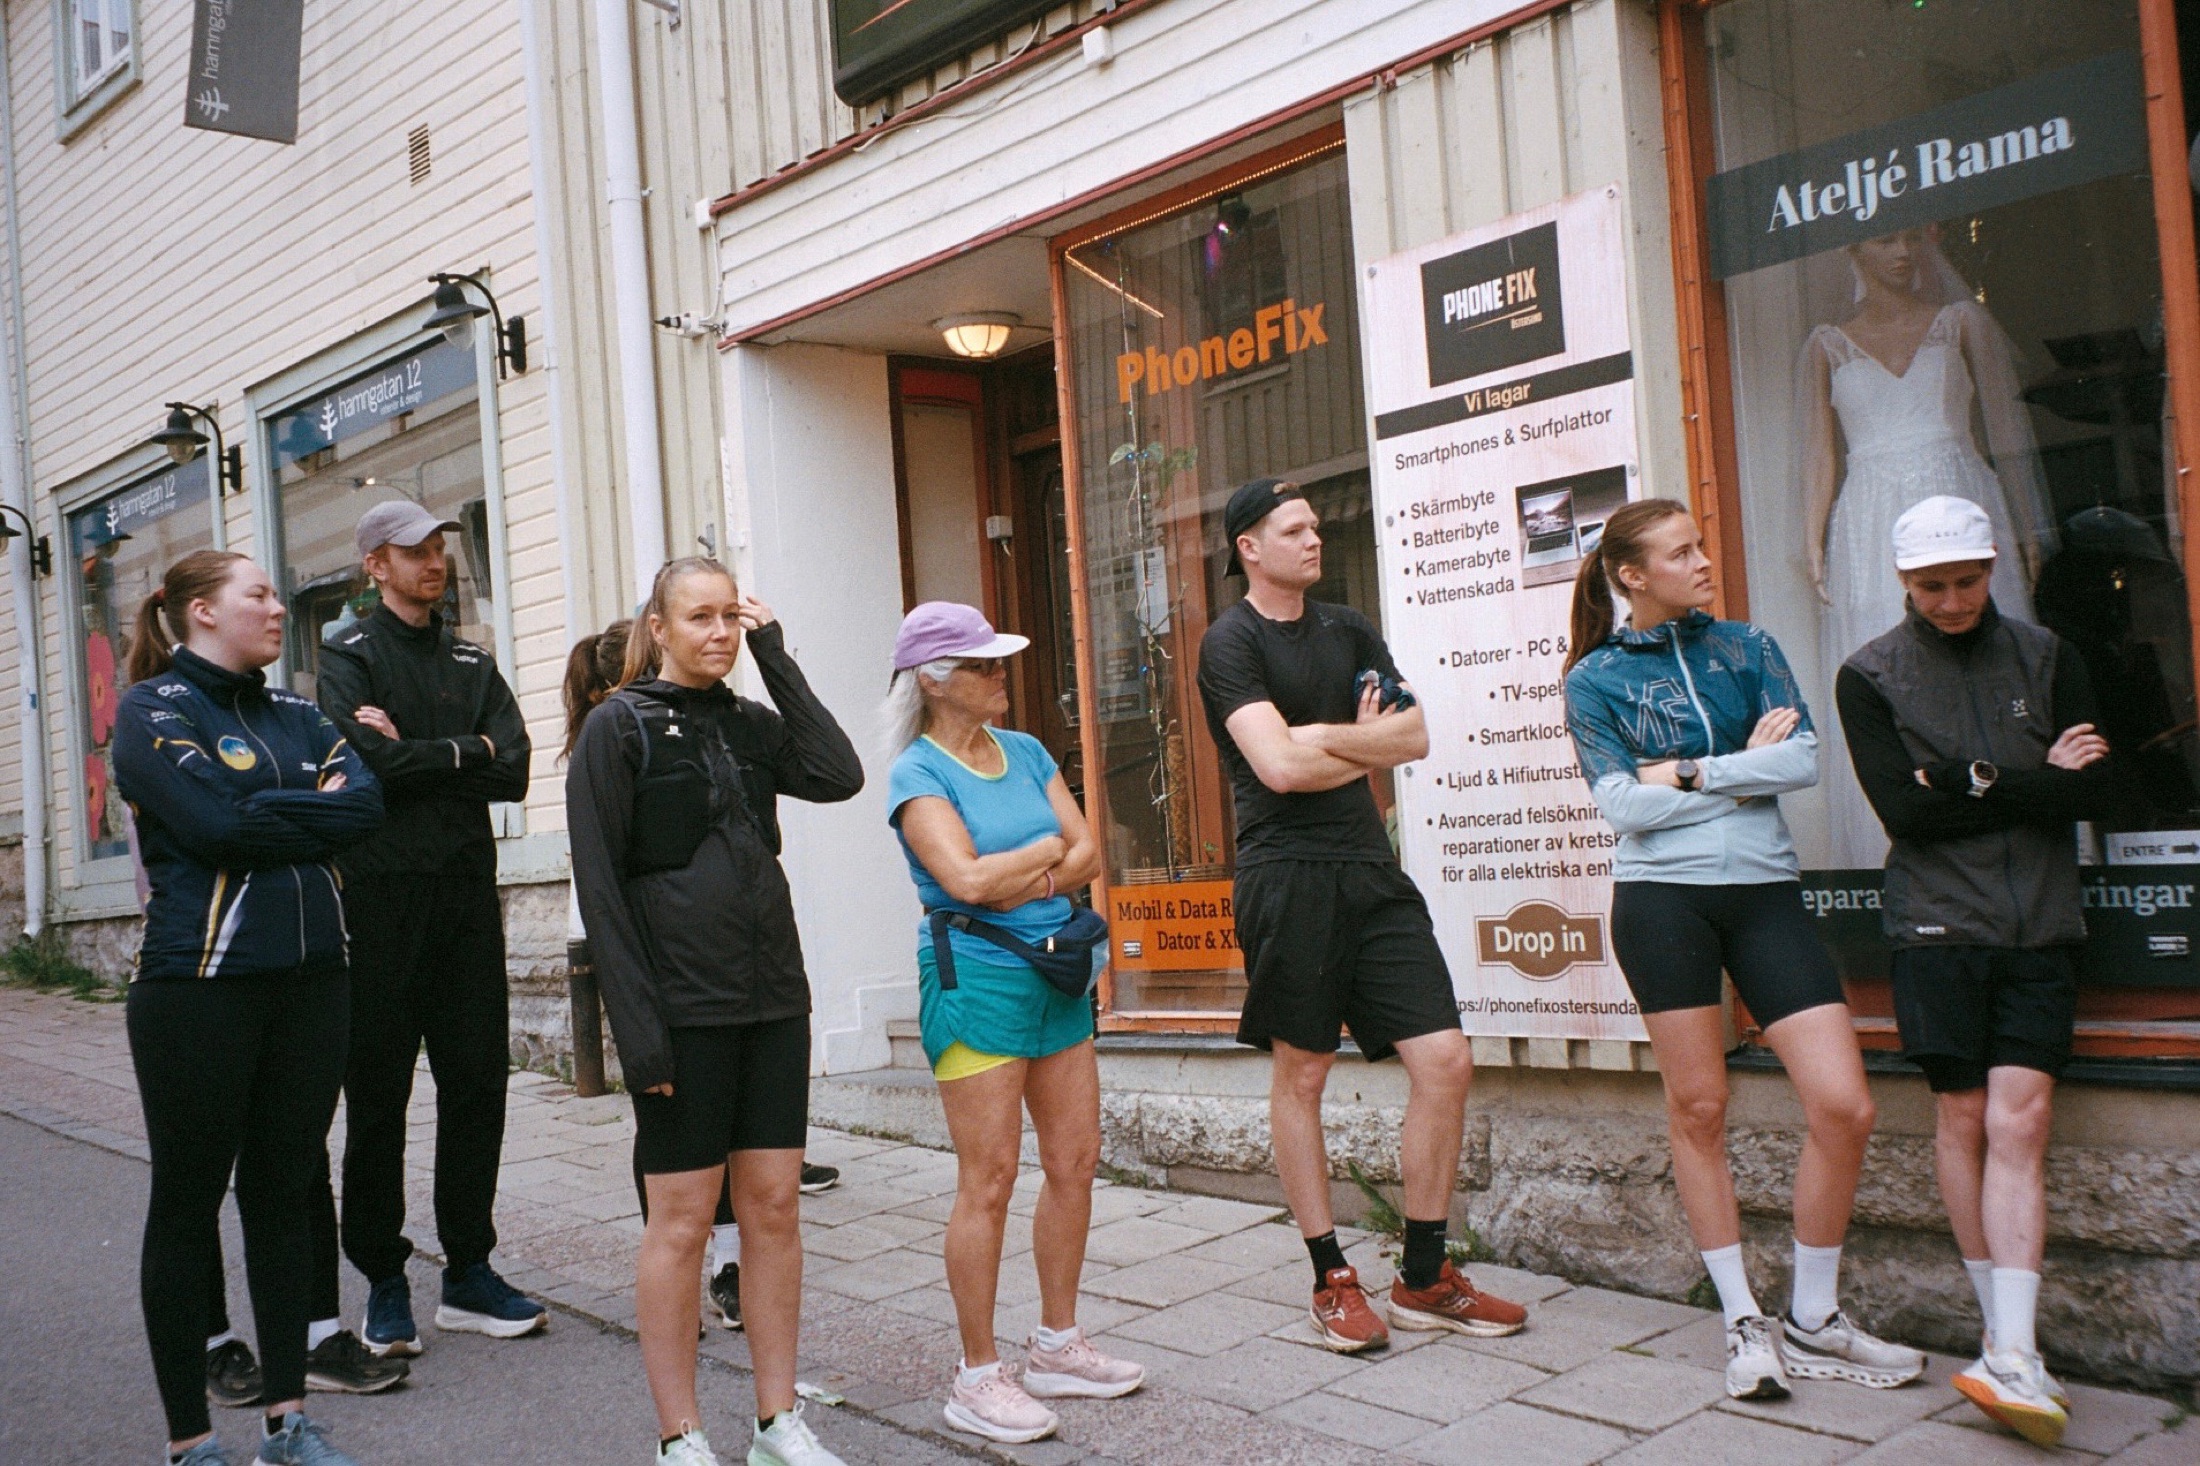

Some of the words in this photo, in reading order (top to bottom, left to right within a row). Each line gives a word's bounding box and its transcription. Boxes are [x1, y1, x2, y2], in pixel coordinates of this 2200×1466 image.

[1767, 148, 1909, 233] Ateljé
[1914, 115, 2076, 191] Rama
[1442, 277, 1504, 325] PHONE
[1506, 266, 1538, 306] FIX
[1115, 298, 1329, 405] PhoneFix
[338, 373, 404, 420] hamngatan
[406, 358, 422, 390] 12
[1463, 393, 1482, 414] Vi
[1485, 382, 1532, 410] lagar
[1395, 434, 1499, 471] Smartphones
[1504, 428, 1516, 447] &
[1520, 407, 1613, 442] Surfplattor
[164, 474, 177, 499] 12
[1410, 489, 1496, 520] Skärmbyte
[1413, 520, 1500, 549] Batteribyte
[1415, 548, 1511, 578] Kamerabyte
[1417, 575, 1516, 606] Vattenskada
[1451, 647, 1511, 668] Datorer
[1527, 637, 1552, 658] PC
[1556, 635, 1568, 654] &
[1447, 770, 1482, 793] Ljud
[1486, 768, 1499, 786] &
[1503, 761, 1585, 785] Hifiutrust
[1438, 808, 1523, 830] Avancerad
[1443, 835, 1541, 859] reparationer
[1545, 836, 1564, 850] av
[2122, 844, 2166, 858] ENTRE
[1442, 864, 1464, 883] för
[1469, 864, 1496, 882] alla
[1500, 860, 1582, 881] elektriska
[1117, 899, 1162, 922] Mobil
[1165, 900, 1177, 920] &
[1180, 898, 1218, 920] Data
[1801, 886, 1886, 917] epara
[1156, 930, 1201, 951] Dator
[1204, 930, 1217, 950] &
[1493, 925, 1556, 959] Drop
[1560, 923, 1586, 952] in
[1456, 996, 1639, 1016] ps://phonefixostersunda
